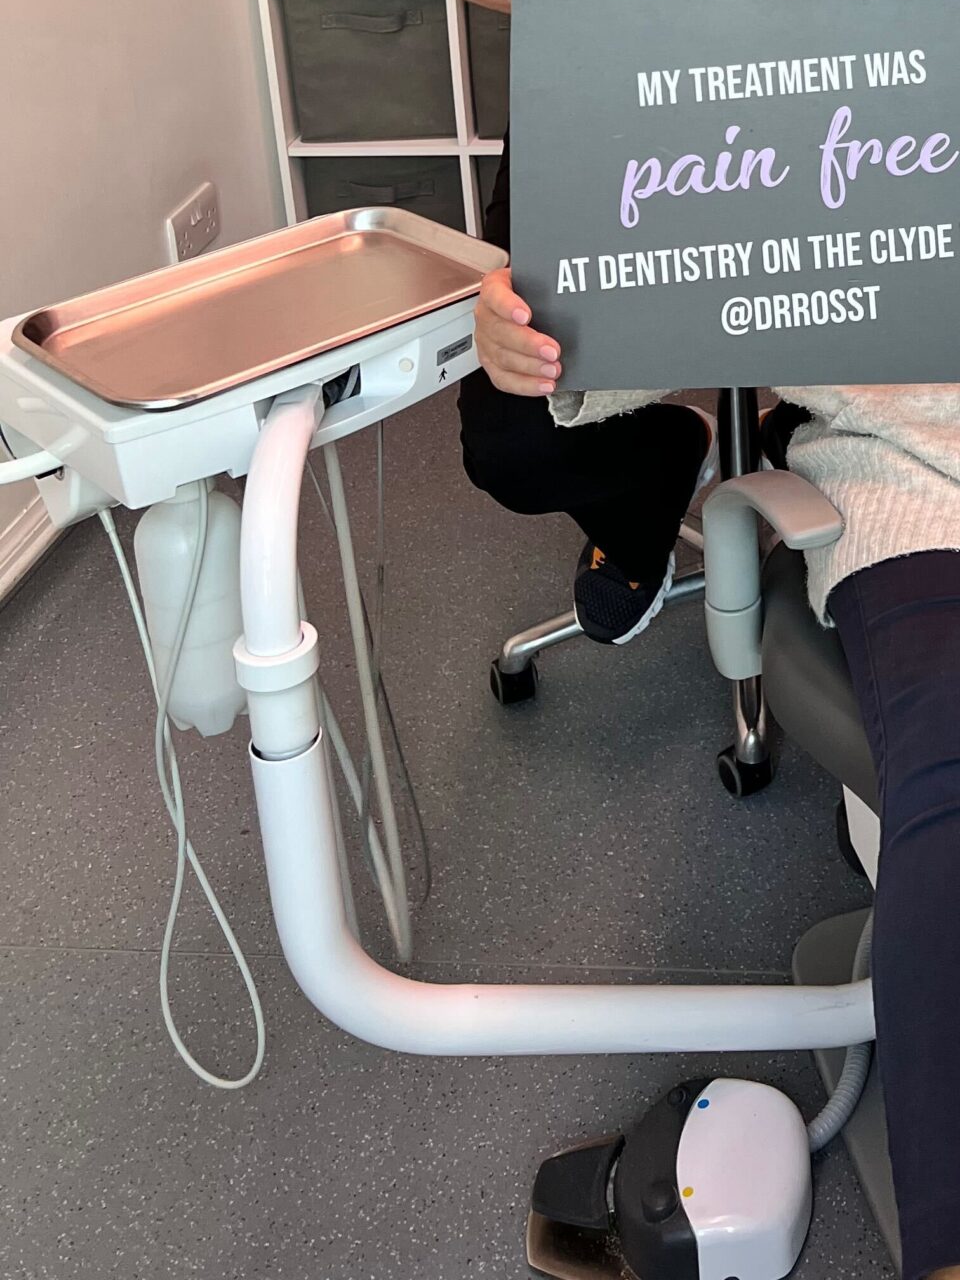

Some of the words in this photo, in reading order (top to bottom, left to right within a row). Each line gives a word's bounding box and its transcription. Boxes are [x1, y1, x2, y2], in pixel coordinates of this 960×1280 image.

[637, 69, 681, 108] MY
[688, 54, 857, 102] TREATMENT
[864, 49, 927, 87] WAS
[619, 124, 791, 229] pain
[818, 105, 960, 210] free
[556, 256, 590, 294] AT
[598, 241, 754, 290] DENTISTRY
[762, 236, 801, 275] ON
[807, 231, 864, 270] THE
[869, 224, 955, 265] CLYDE
[721, 285, 881, 336] @DRROSST
